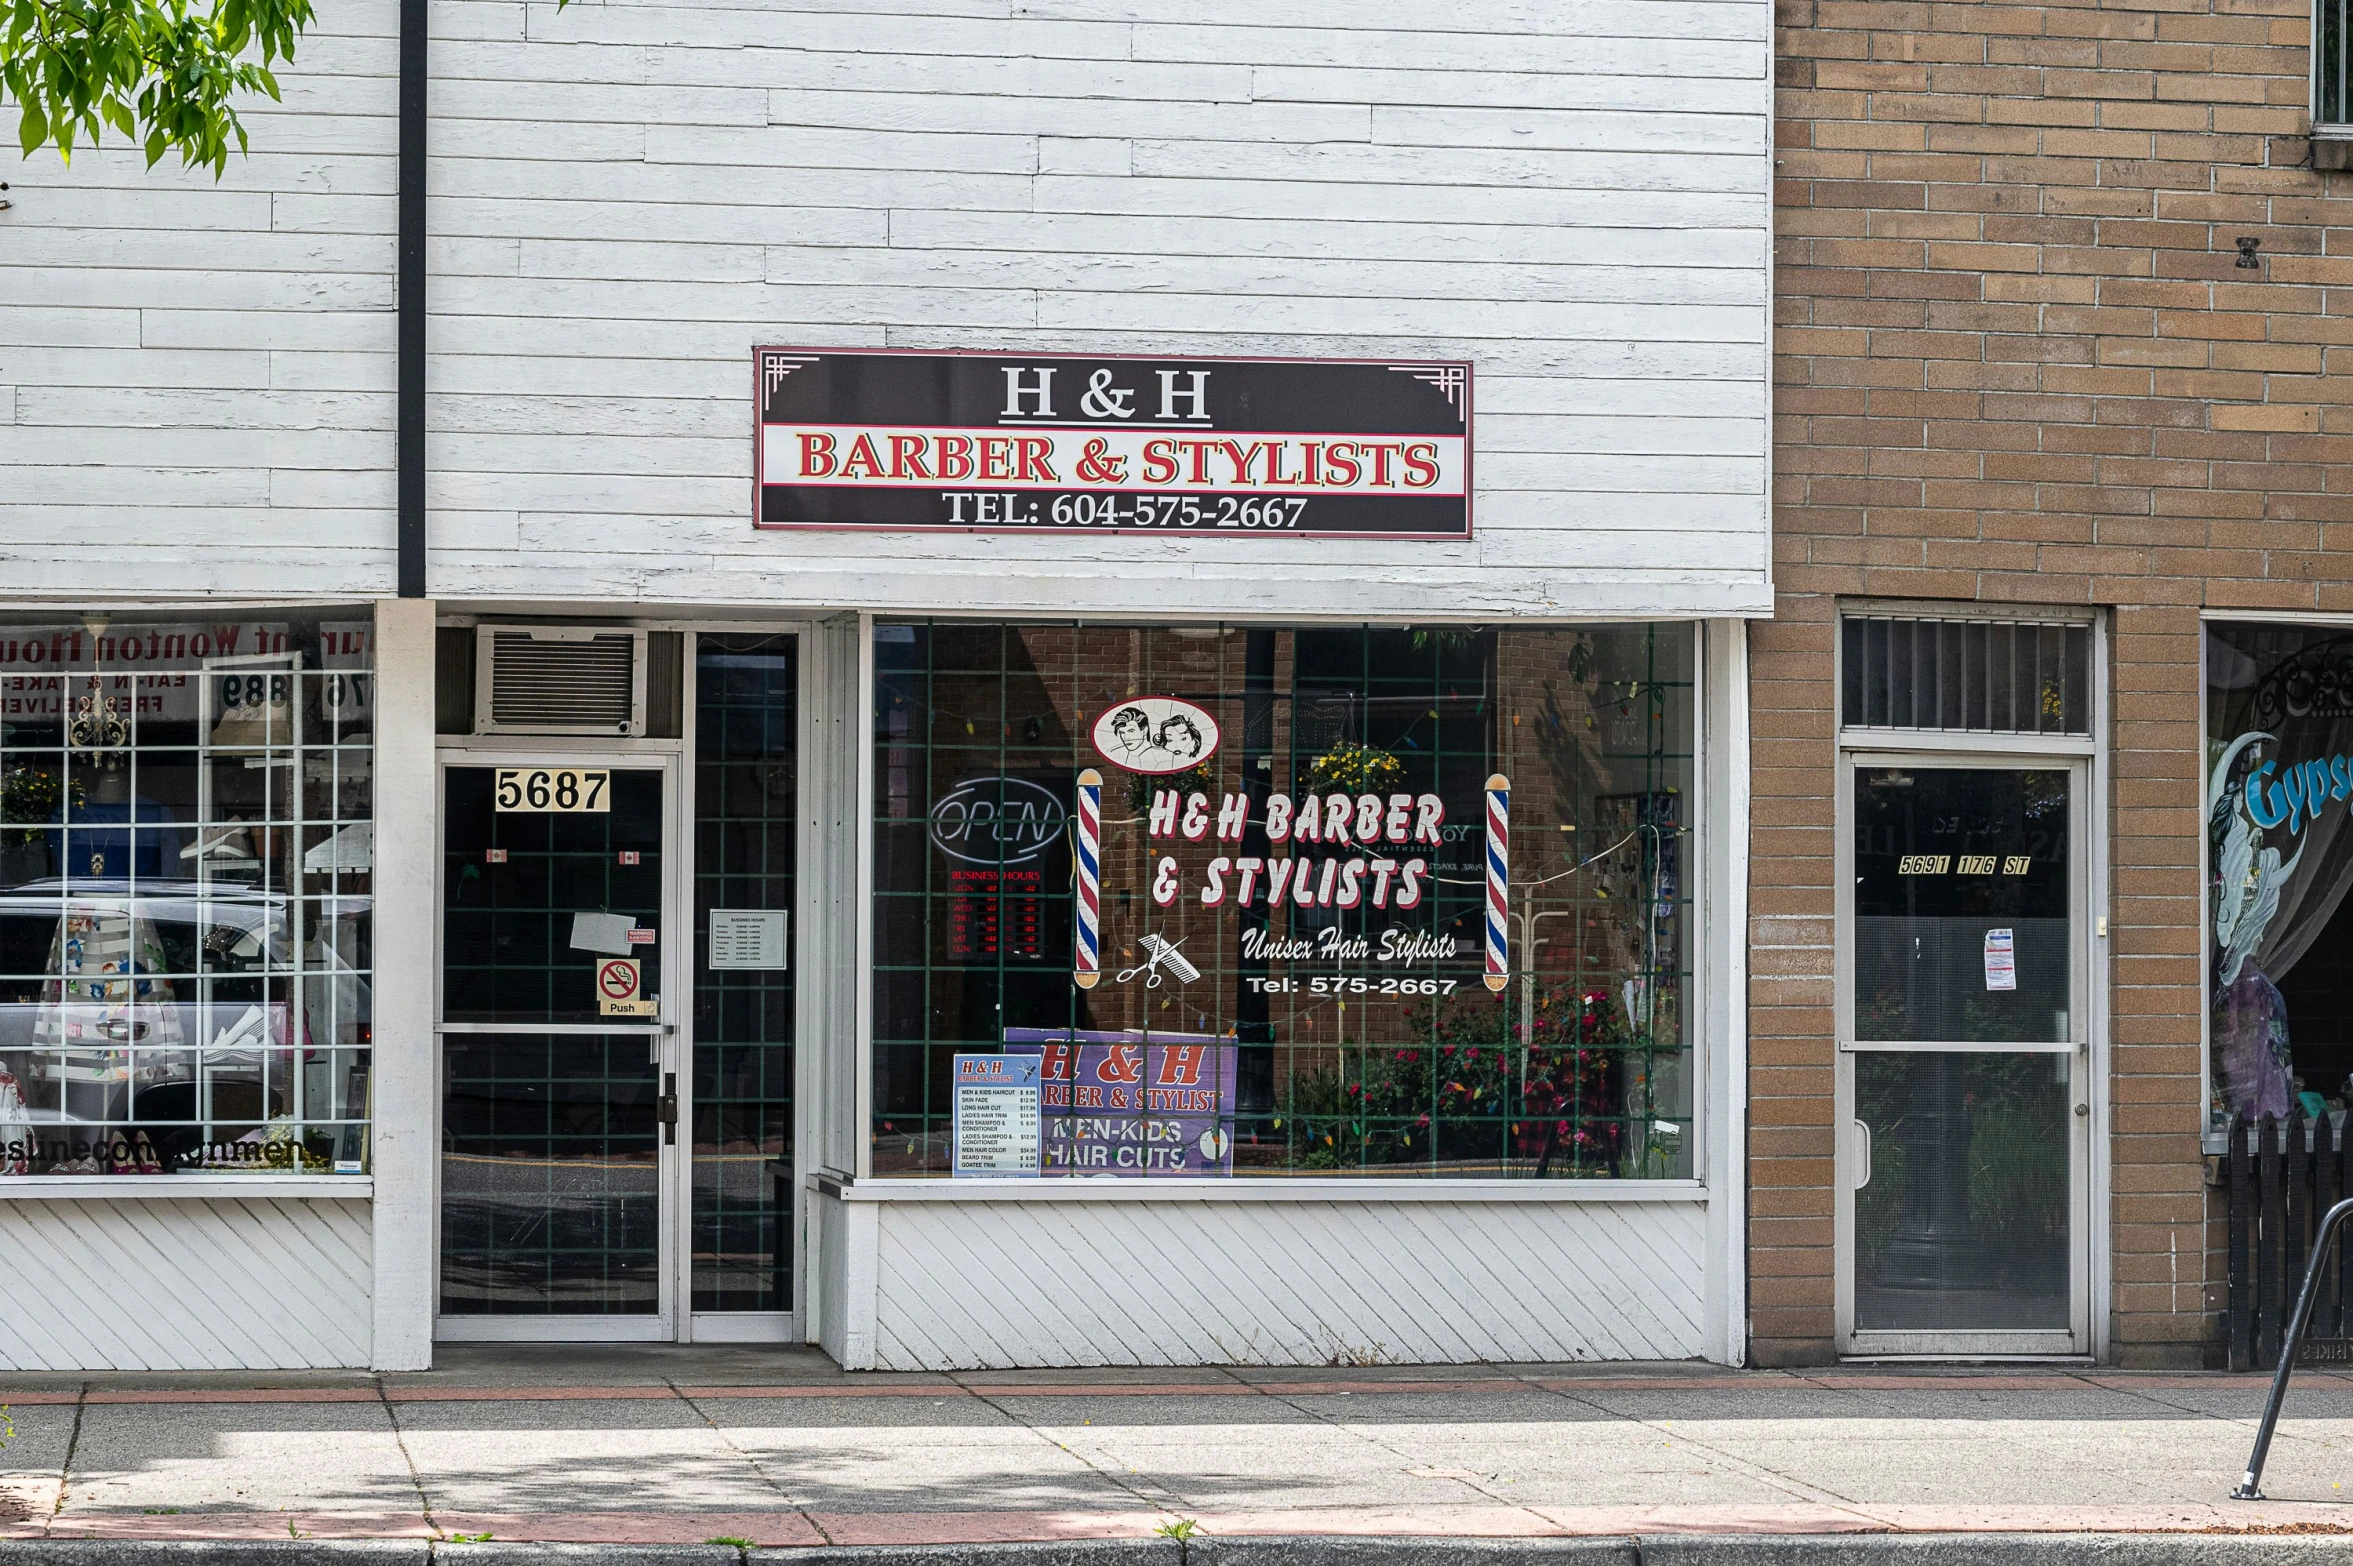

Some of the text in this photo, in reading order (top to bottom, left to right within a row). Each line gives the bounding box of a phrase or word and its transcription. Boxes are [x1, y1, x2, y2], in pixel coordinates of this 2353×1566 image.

[1001, 367, 1211, 419] H & H
[796, 432, 1441, 489] BARBER & STYLISTS
[942, 492, 1308, 528] TEL: 604-575-2667
[498, 771, 607, 809] 5687
[2245, 753, 2353, 836] Gyps
[937, 801, 1052, 841] OPEN
[1265, 793, 1446, 847] BARBER
[952, 871, 1040, 880] BUSINESS HOURS
[1152, 856, 1428, 909] & STYLISTS
[1901, 857, 2030, 874] 5691 176 ST
[1241, 926, 1457, 968] Unisex Hair Stylists
[1246, 977, 1458, 995] Tel: 575-2667
[610, 1003, 635, 1013] Push
[961, 1060, 1004, 1075] H & H
[1040, 1039, 1206, 1086] H & H
[1041, 1084, 1223, 1113] RBER & STYLIST
[1048, 1143, 1186, 1170] HAIR CUTS
